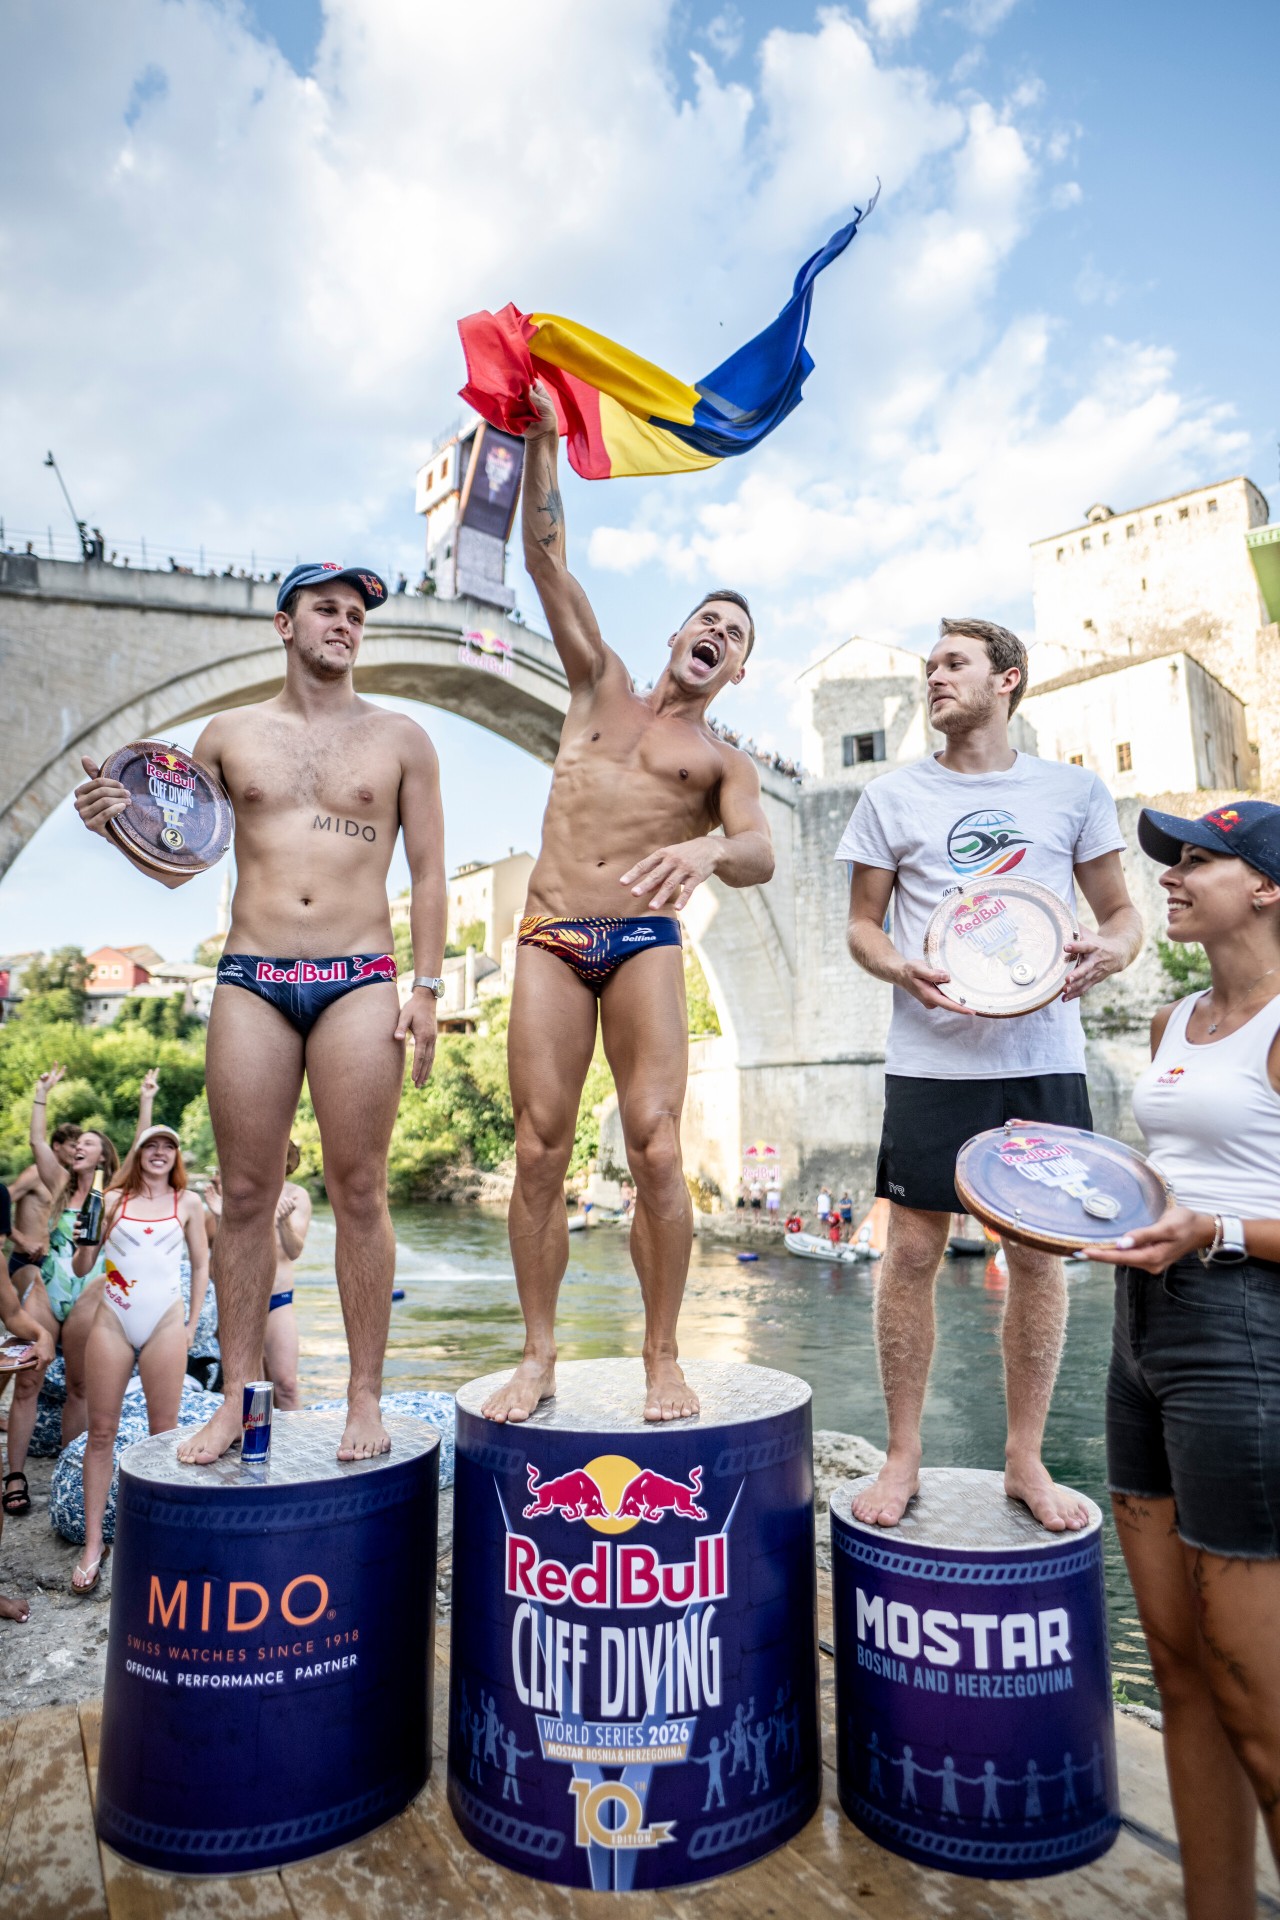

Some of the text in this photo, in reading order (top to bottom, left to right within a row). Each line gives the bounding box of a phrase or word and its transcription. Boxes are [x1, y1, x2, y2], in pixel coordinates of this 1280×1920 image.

[147, 763, 195, 790] Red Bull
[149, 777, 167, 799] CLIFF
[168, 785, 194, 808] DIVING
[170, 831, 178, 842] 2
[313, 814, 376, 842] MIDO
[953, 899, 1007, 936] Red Bull
[621, 934, 657, 943] Delfina
[256, 961, 347, 983] Red Bull
[1016, 964, 1028, 976] 3
[1001, 1144, 1073, 1166] Red Bull
[888, 1181, 905, 1197] TYR
[506, 1532, 728, 1609] Red Bull
[855, 1586, 1072, 1670] MOSTAR
[127, 1629, 360, 1662] SWISS WATCHES SINCE 1918
[125, 1653, 358, 1688] OFFICIAL PERFORMANCE PARTNER
[512, 1602, 722, 1718] CLIFF DIVING
[856, 1643, 1074, 1698] BOSNIA AND HERZEGOVINA
[543, 1721, 690, 1747] WORLD SERIES 2026
[548, 1743, 583, 1760] MOSTAR
[611, 1833, 652, 1845] EDITION
